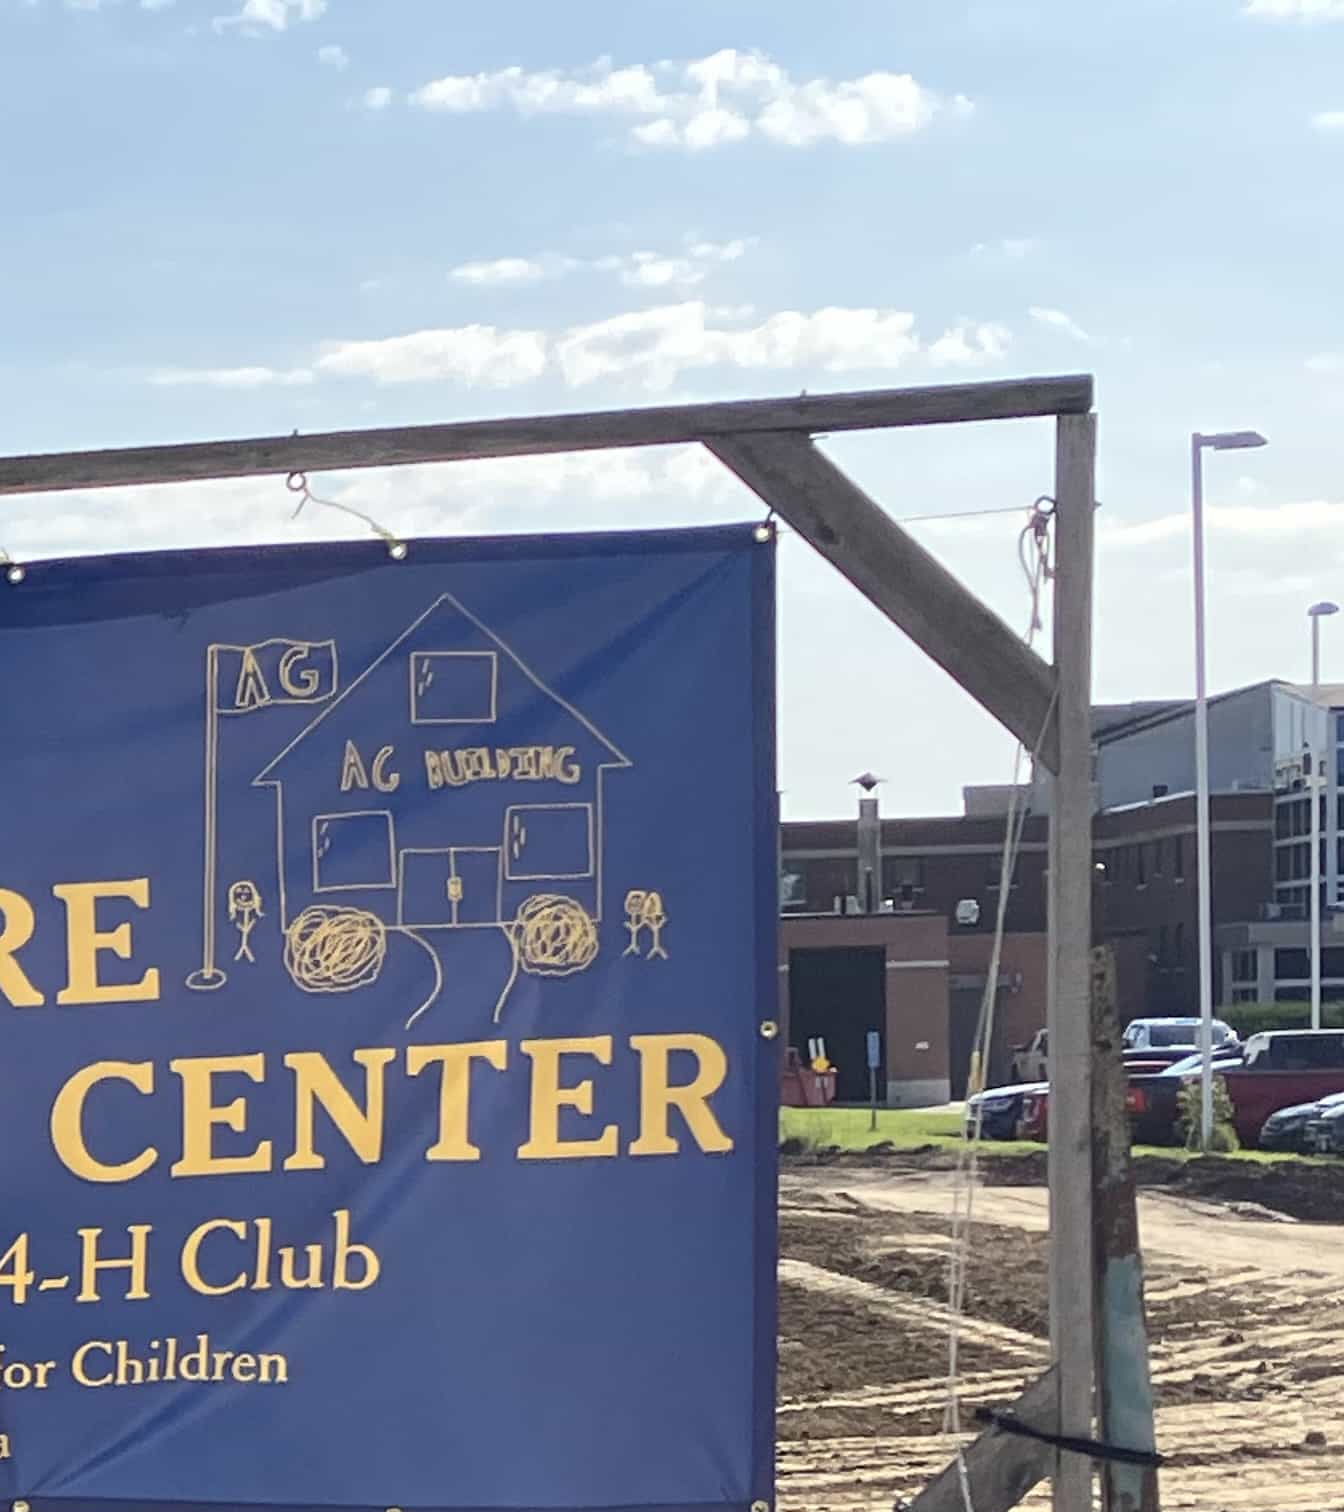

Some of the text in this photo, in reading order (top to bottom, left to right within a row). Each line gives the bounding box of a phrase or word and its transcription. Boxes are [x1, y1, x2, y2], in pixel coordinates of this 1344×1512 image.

[235, 645, 319, 707] AG
[340, 739, 580, 792] AG BUILDING
[50, 1032, 734, 1183] CENTER
[180, 1208, 381, 1297] Club
[70, 1333, 289, 1389] Children
